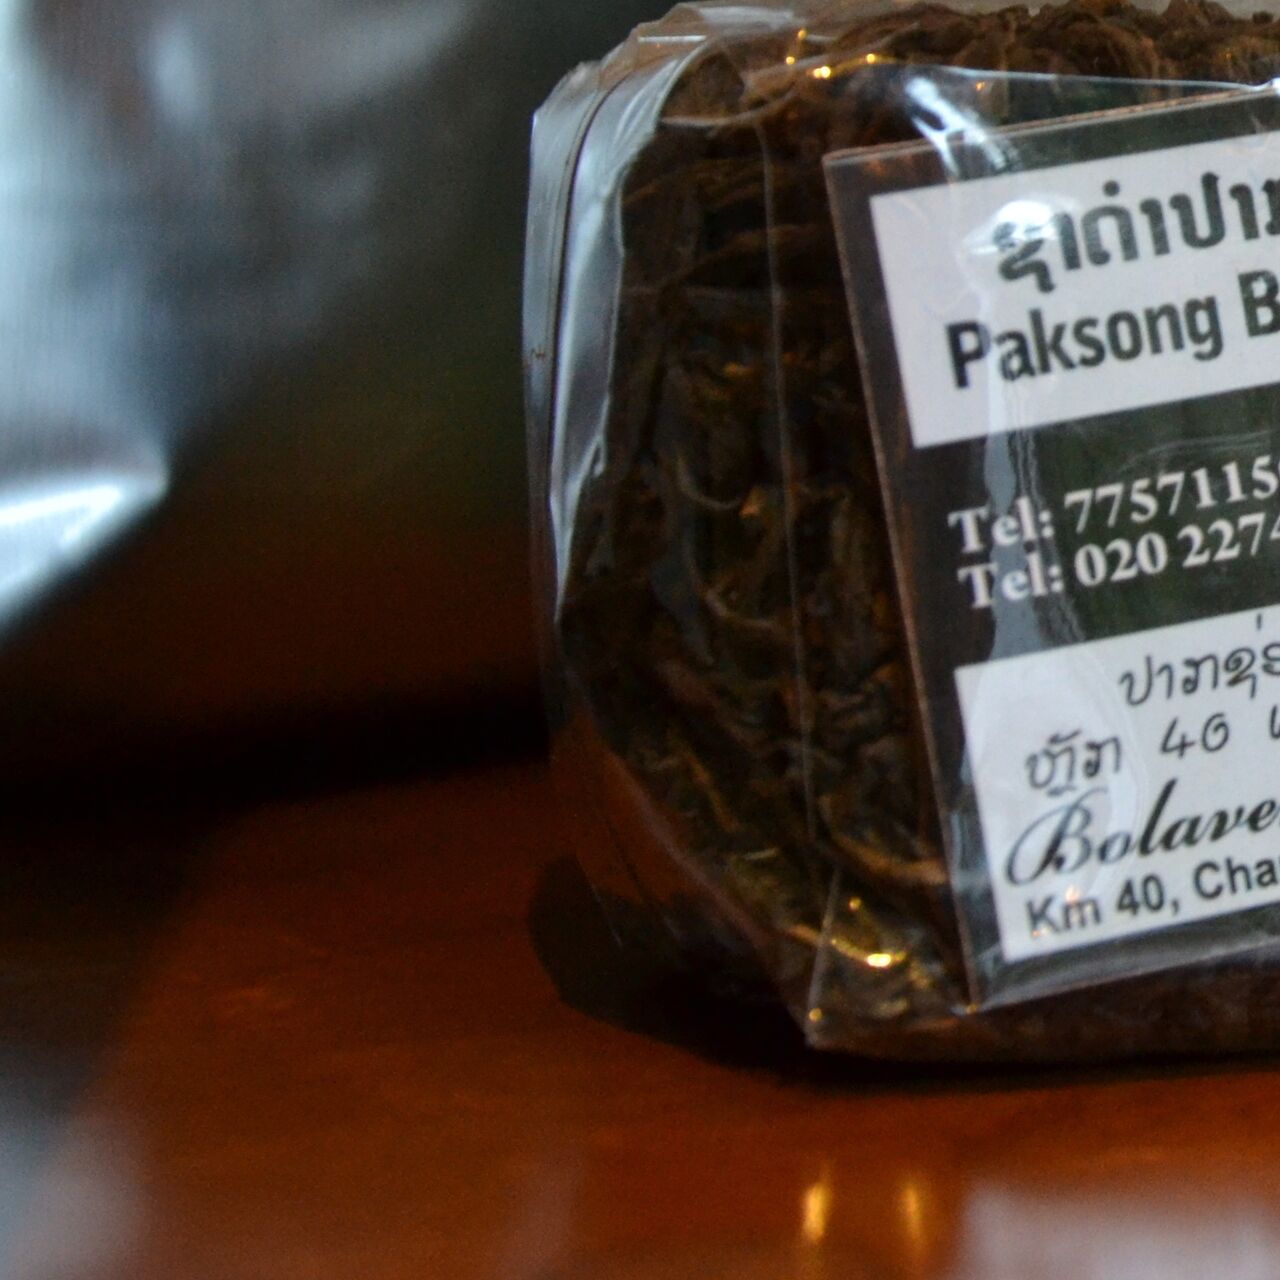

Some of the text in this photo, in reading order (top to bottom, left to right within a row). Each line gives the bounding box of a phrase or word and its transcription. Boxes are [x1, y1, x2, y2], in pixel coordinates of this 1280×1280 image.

[945, 296, 1223, 390] Paksong
[948, 497, 1055, 555] Tel:
[957, 546, 1064, 608] Tel:
[1075, 538, 1169, 588] 020
[1024, 894, 1102, 939] Km
[1115, 875, 1181, 915] 40,
